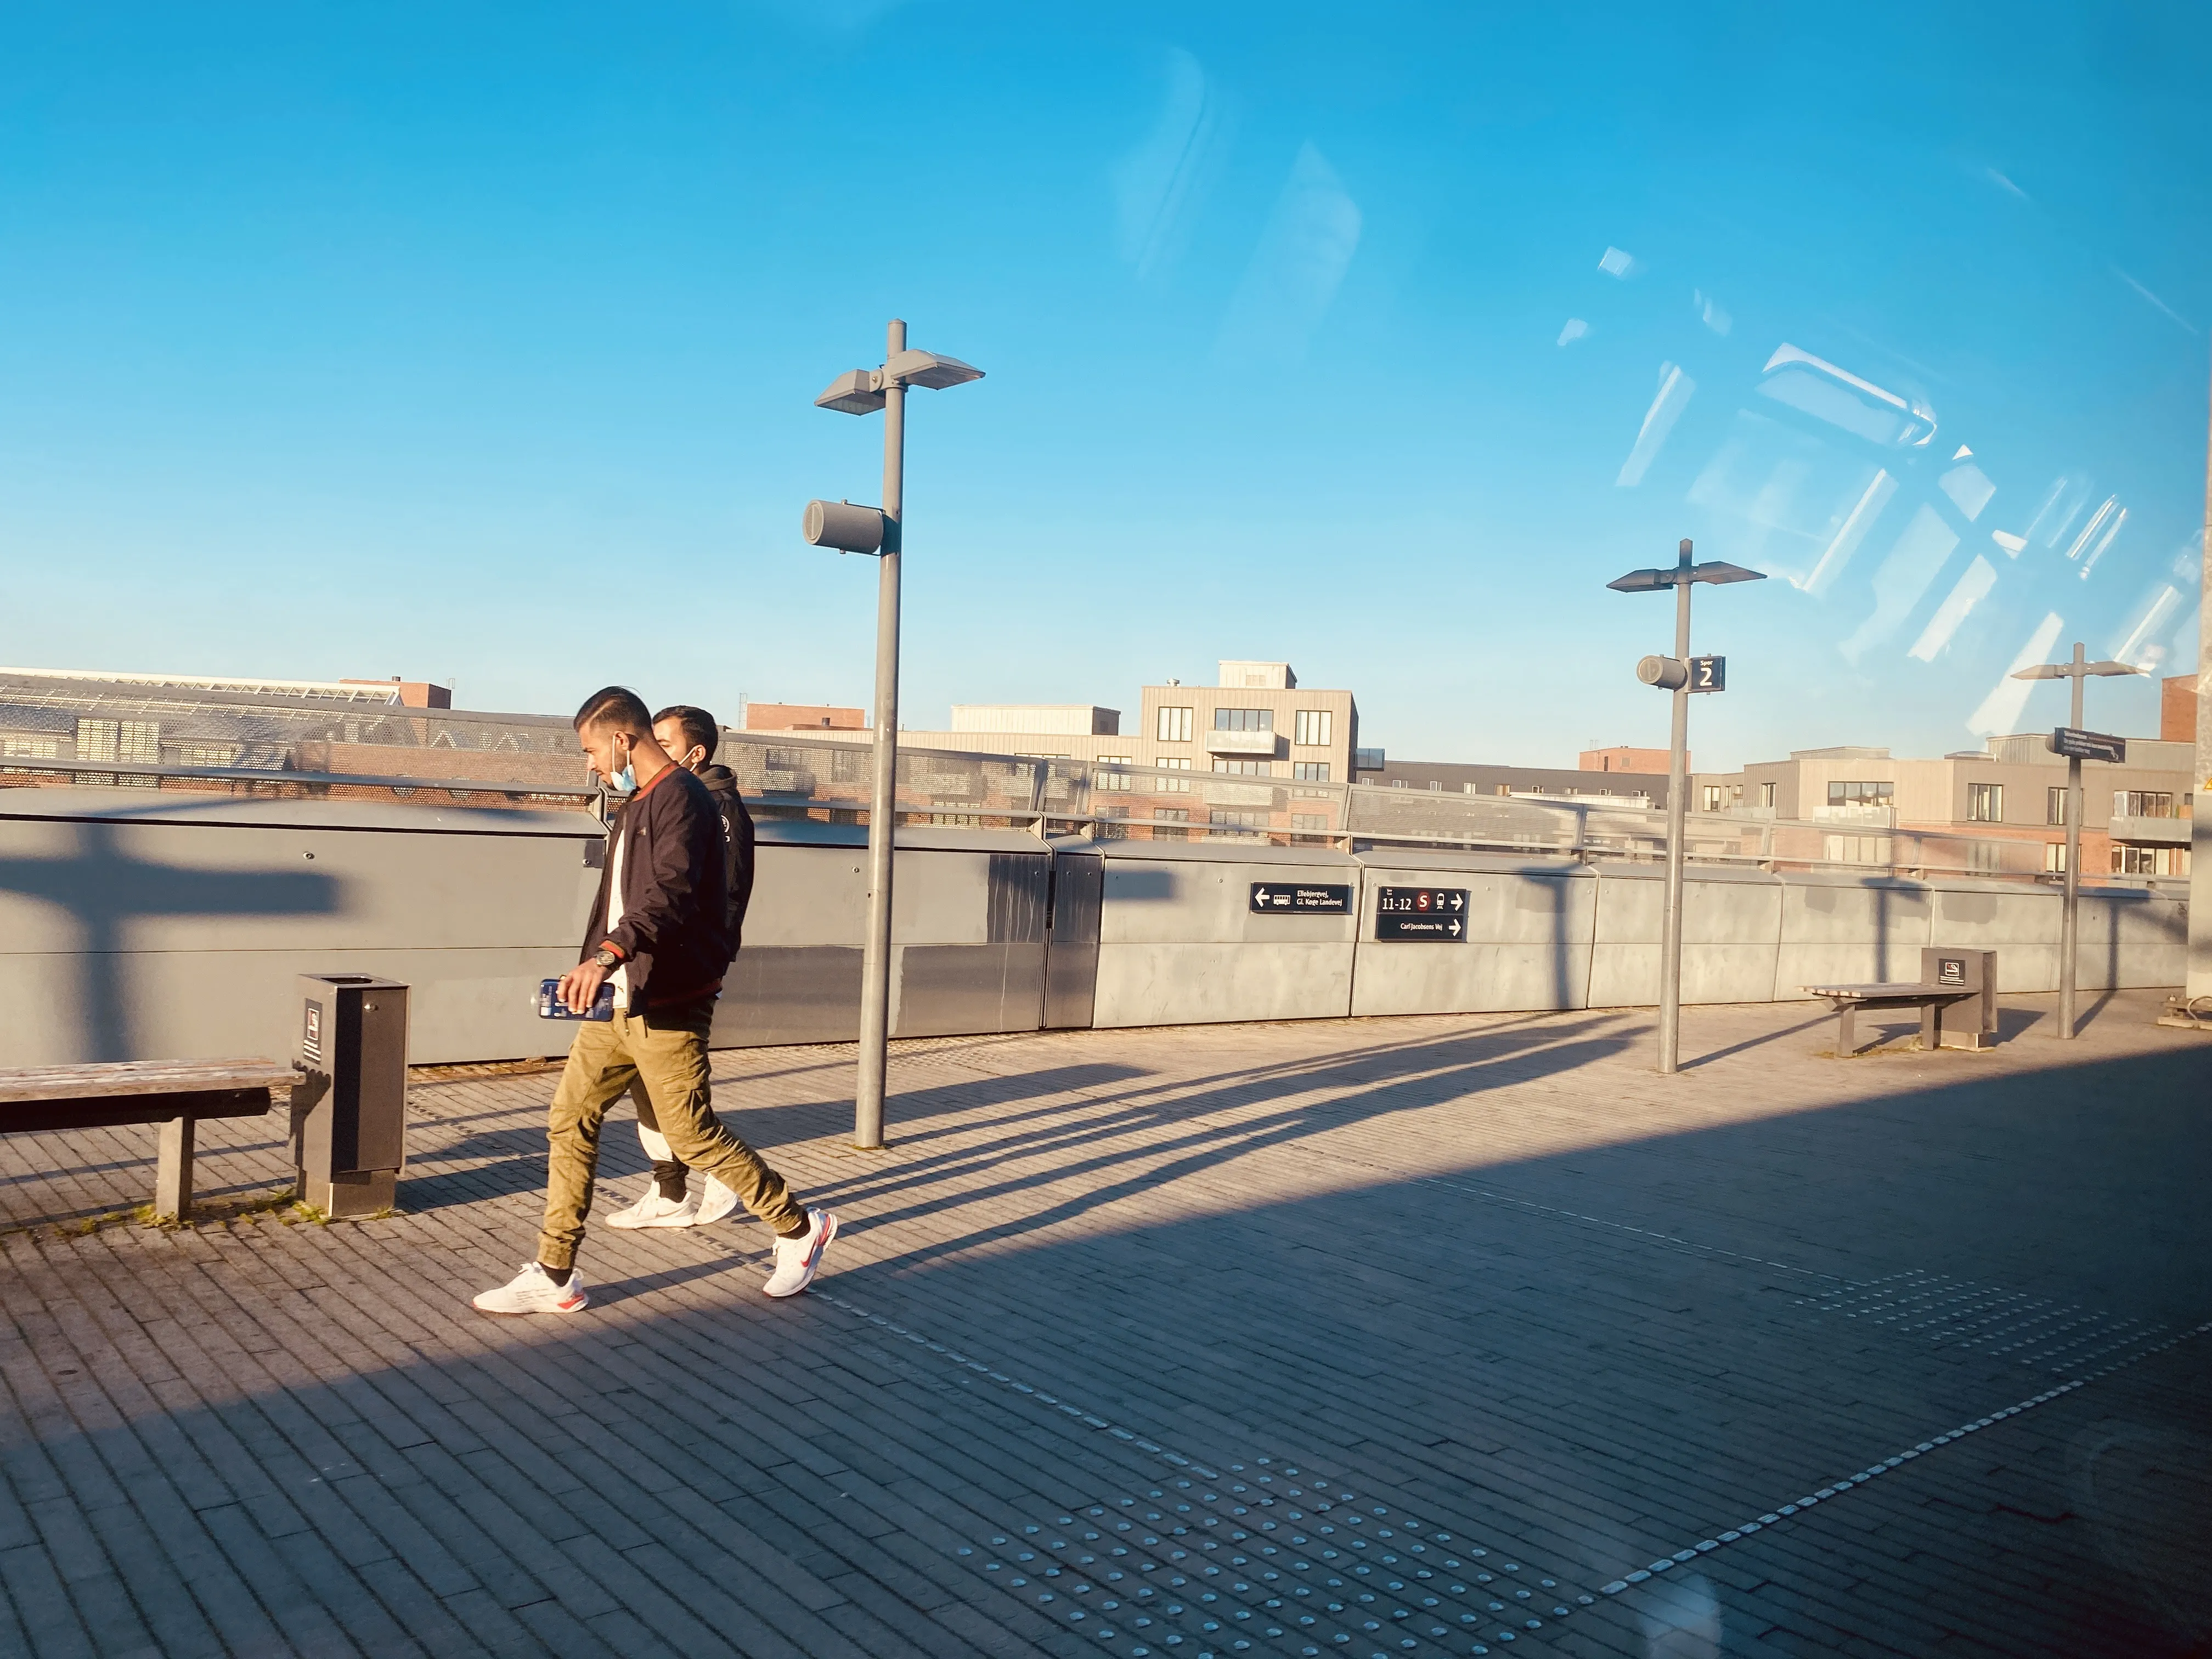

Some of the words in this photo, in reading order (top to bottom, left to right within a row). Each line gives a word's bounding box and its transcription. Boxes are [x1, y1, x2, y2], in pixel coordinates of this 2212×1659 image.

[1700, 667, 1712, 686] 2
[1297, 890, 1329, 899] Ellebjergvej,
[1319, 899, 1342, 907] Landevej
[1382, 898, 1412, 910] 11-12
[1419, 895, 1427, 908] S
[1435, 923, 1443, 932] Vej
